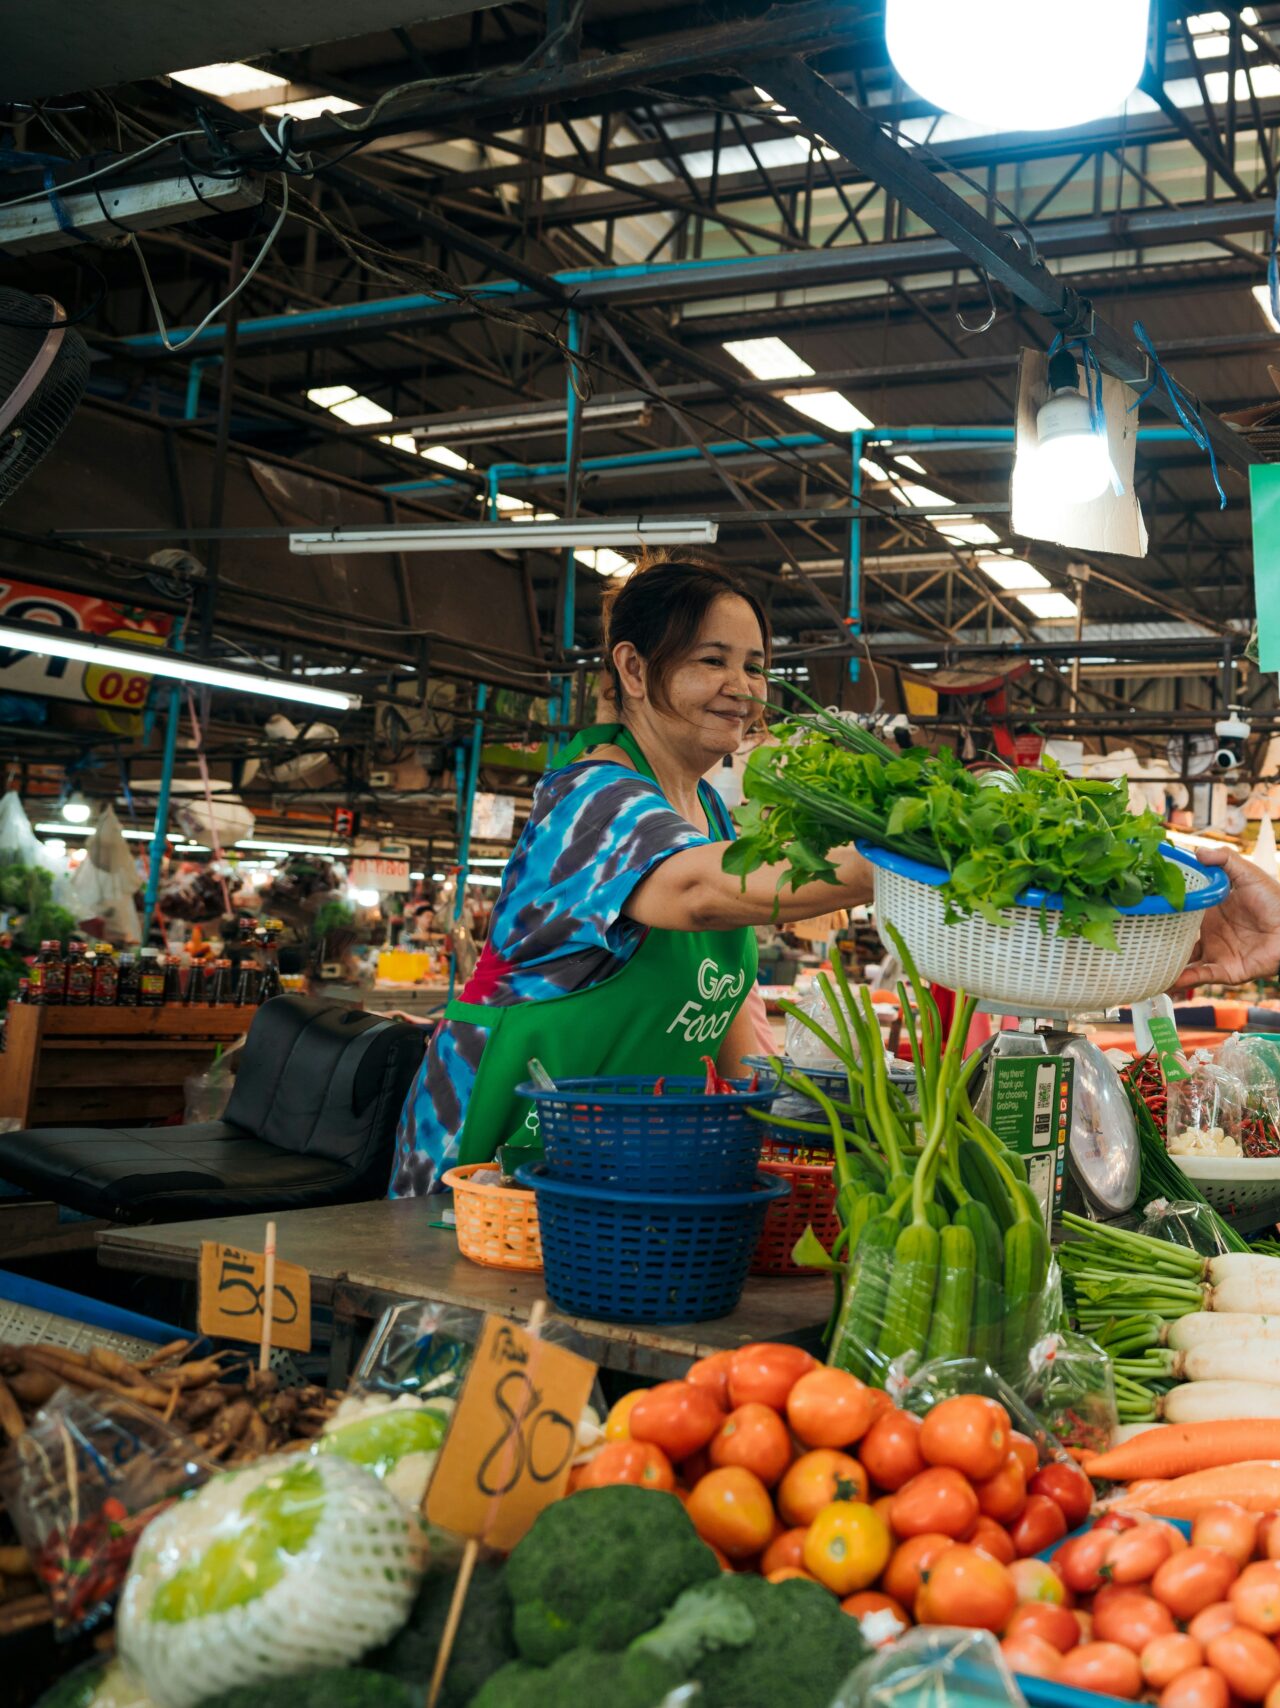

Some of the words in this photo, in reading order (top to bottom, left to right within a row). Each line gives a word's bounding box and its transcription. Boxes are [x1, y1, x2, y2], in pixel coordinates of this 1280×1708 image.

[665, 1000, 738, 1043] Food
[998, 1070, 1009, 1080] Hey
[1010, 1068, 1025, 1078] there!
[998, 1081, 1013, 1089] Thank
[1013, 1081, 1024, 1090] you
[997, 1092, 1005, 1100] for
[1005, 1090, 1028, 1100] choosing
[218, 1261, 298, 1324] 50
[476, 1369, 576, 1498] 80
